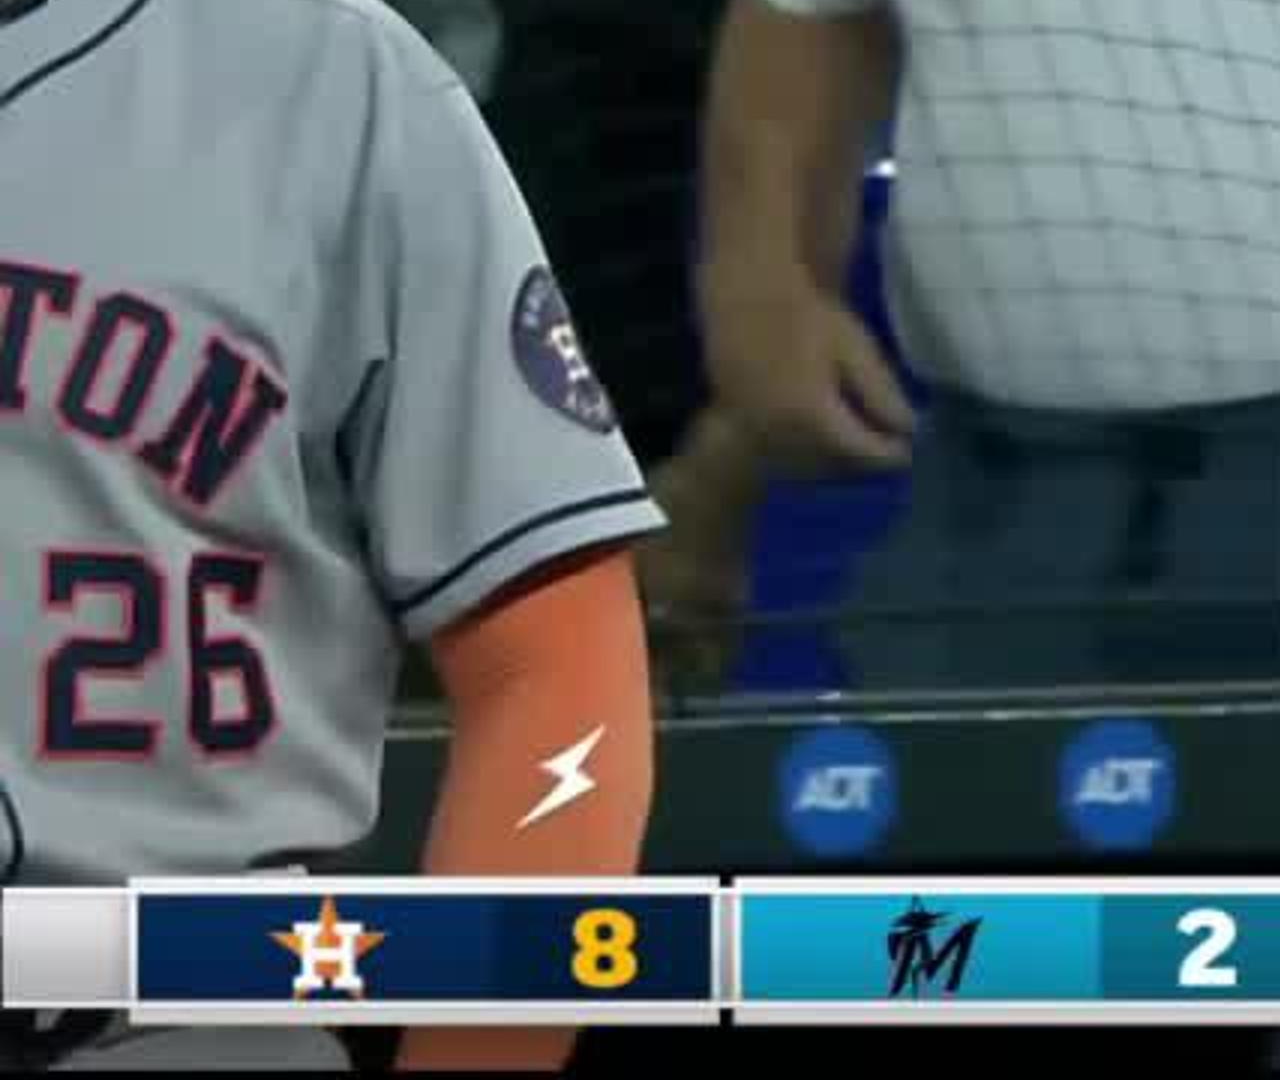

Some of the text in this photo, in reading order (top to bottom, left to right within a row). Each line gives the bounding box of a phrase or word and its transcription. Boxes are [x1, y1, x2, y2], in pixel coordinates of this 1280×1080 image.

[38, 546, 279, 764] 26
[794, 765, 886, 812] ADT
[1076, 757, 1166, 805] ADT
